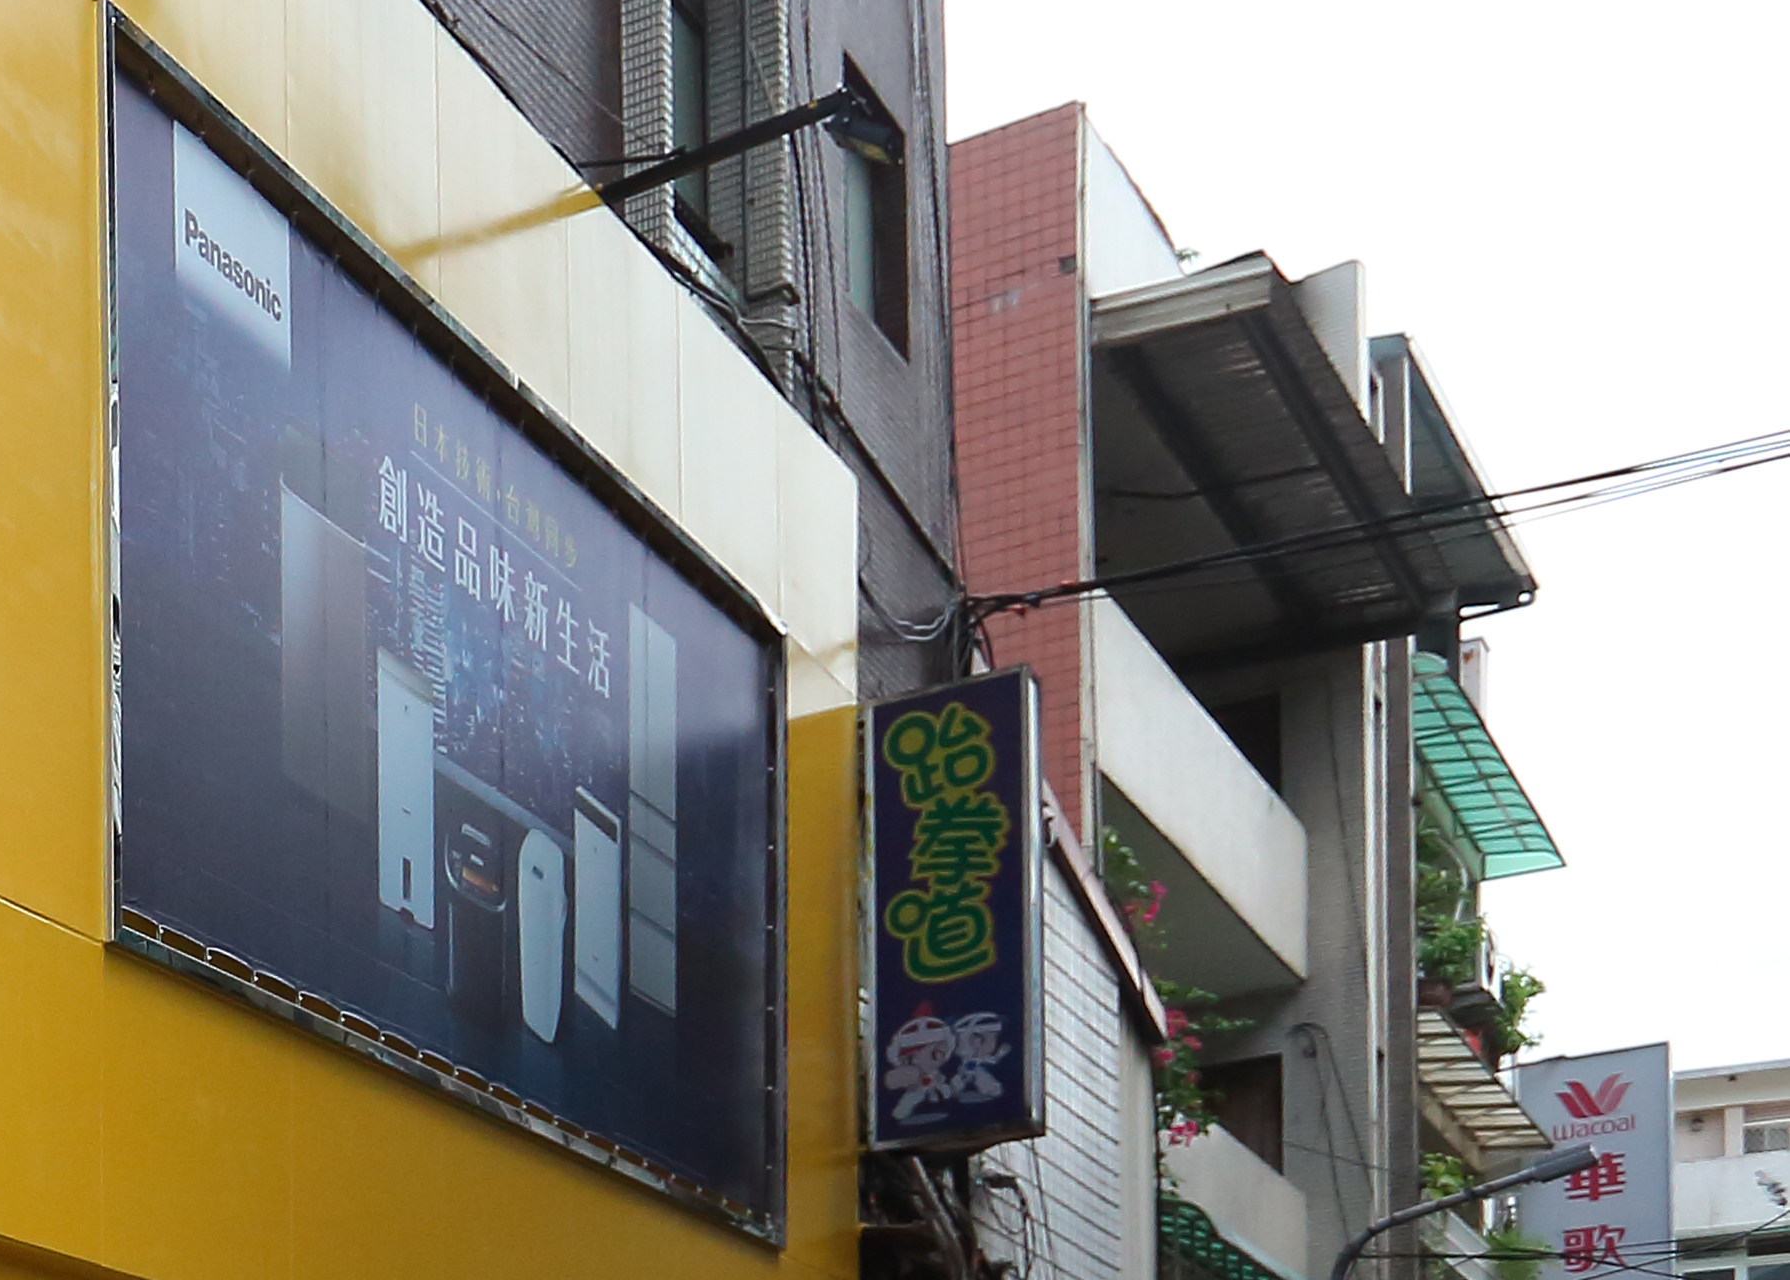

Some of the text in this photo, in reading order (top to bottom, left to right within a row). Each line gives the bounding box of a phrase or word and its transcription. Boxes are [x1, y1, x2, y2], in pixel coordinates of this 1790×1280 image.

[182, 207, 283, 324] Panasonic
[378, 455, 611, 699] 創造品味新生活
[886, 705, 1010, 982] 跆拳道
[1552, 1114, 1636, 1142] Wacoal
